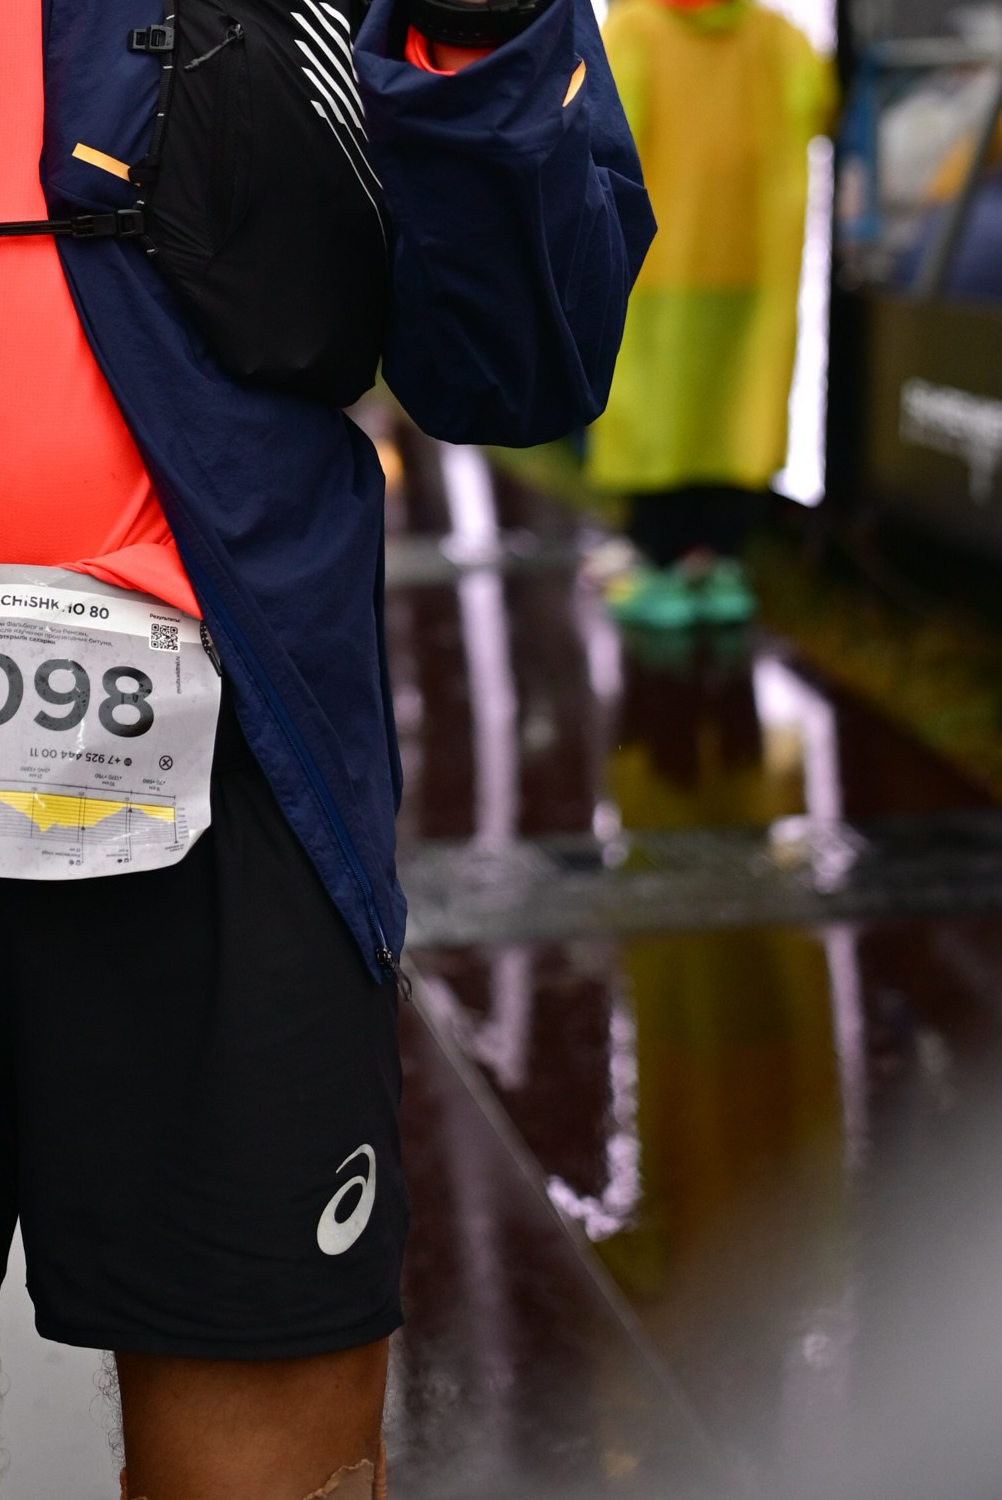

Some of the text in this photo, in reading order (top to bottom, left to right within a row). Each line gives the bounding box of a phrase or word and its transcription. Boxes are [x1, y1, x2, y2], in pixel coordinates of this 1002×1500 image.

[89, 605, 110, 620] 80
[29, 637, 56, 645] сахарин
[29, 747, 38, 757] 11
[41, 749, 57, 759] 00
[85, 752, 105, 763] 925
[107, 755, 121, 764] +7
